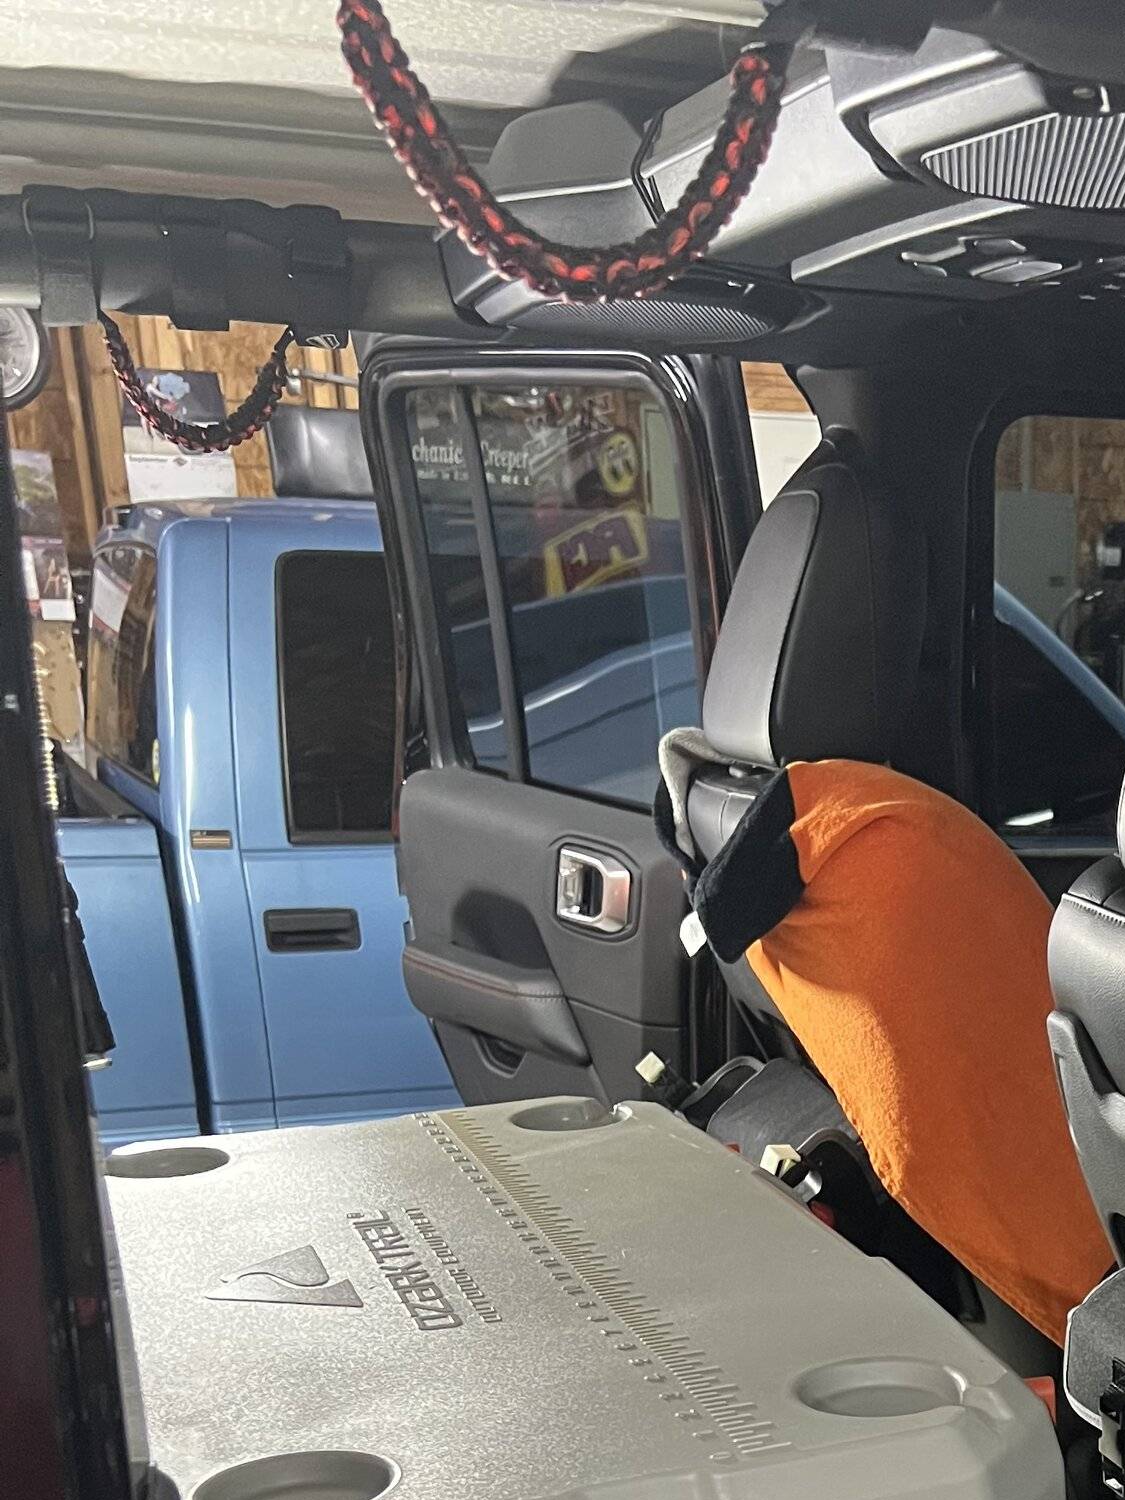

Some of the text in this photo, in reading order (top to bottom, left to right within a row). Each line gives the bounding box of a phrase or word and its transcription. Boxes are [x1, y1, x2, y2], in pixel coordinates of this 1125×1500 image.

[353, 1209, 415, 1264] TRAIL
[401, 1206, 460, 1265] EQUIPMENT
[380, 1262, 463, 1331] OZARK
[446, 1268, 503, 1324] OUTDOOR
